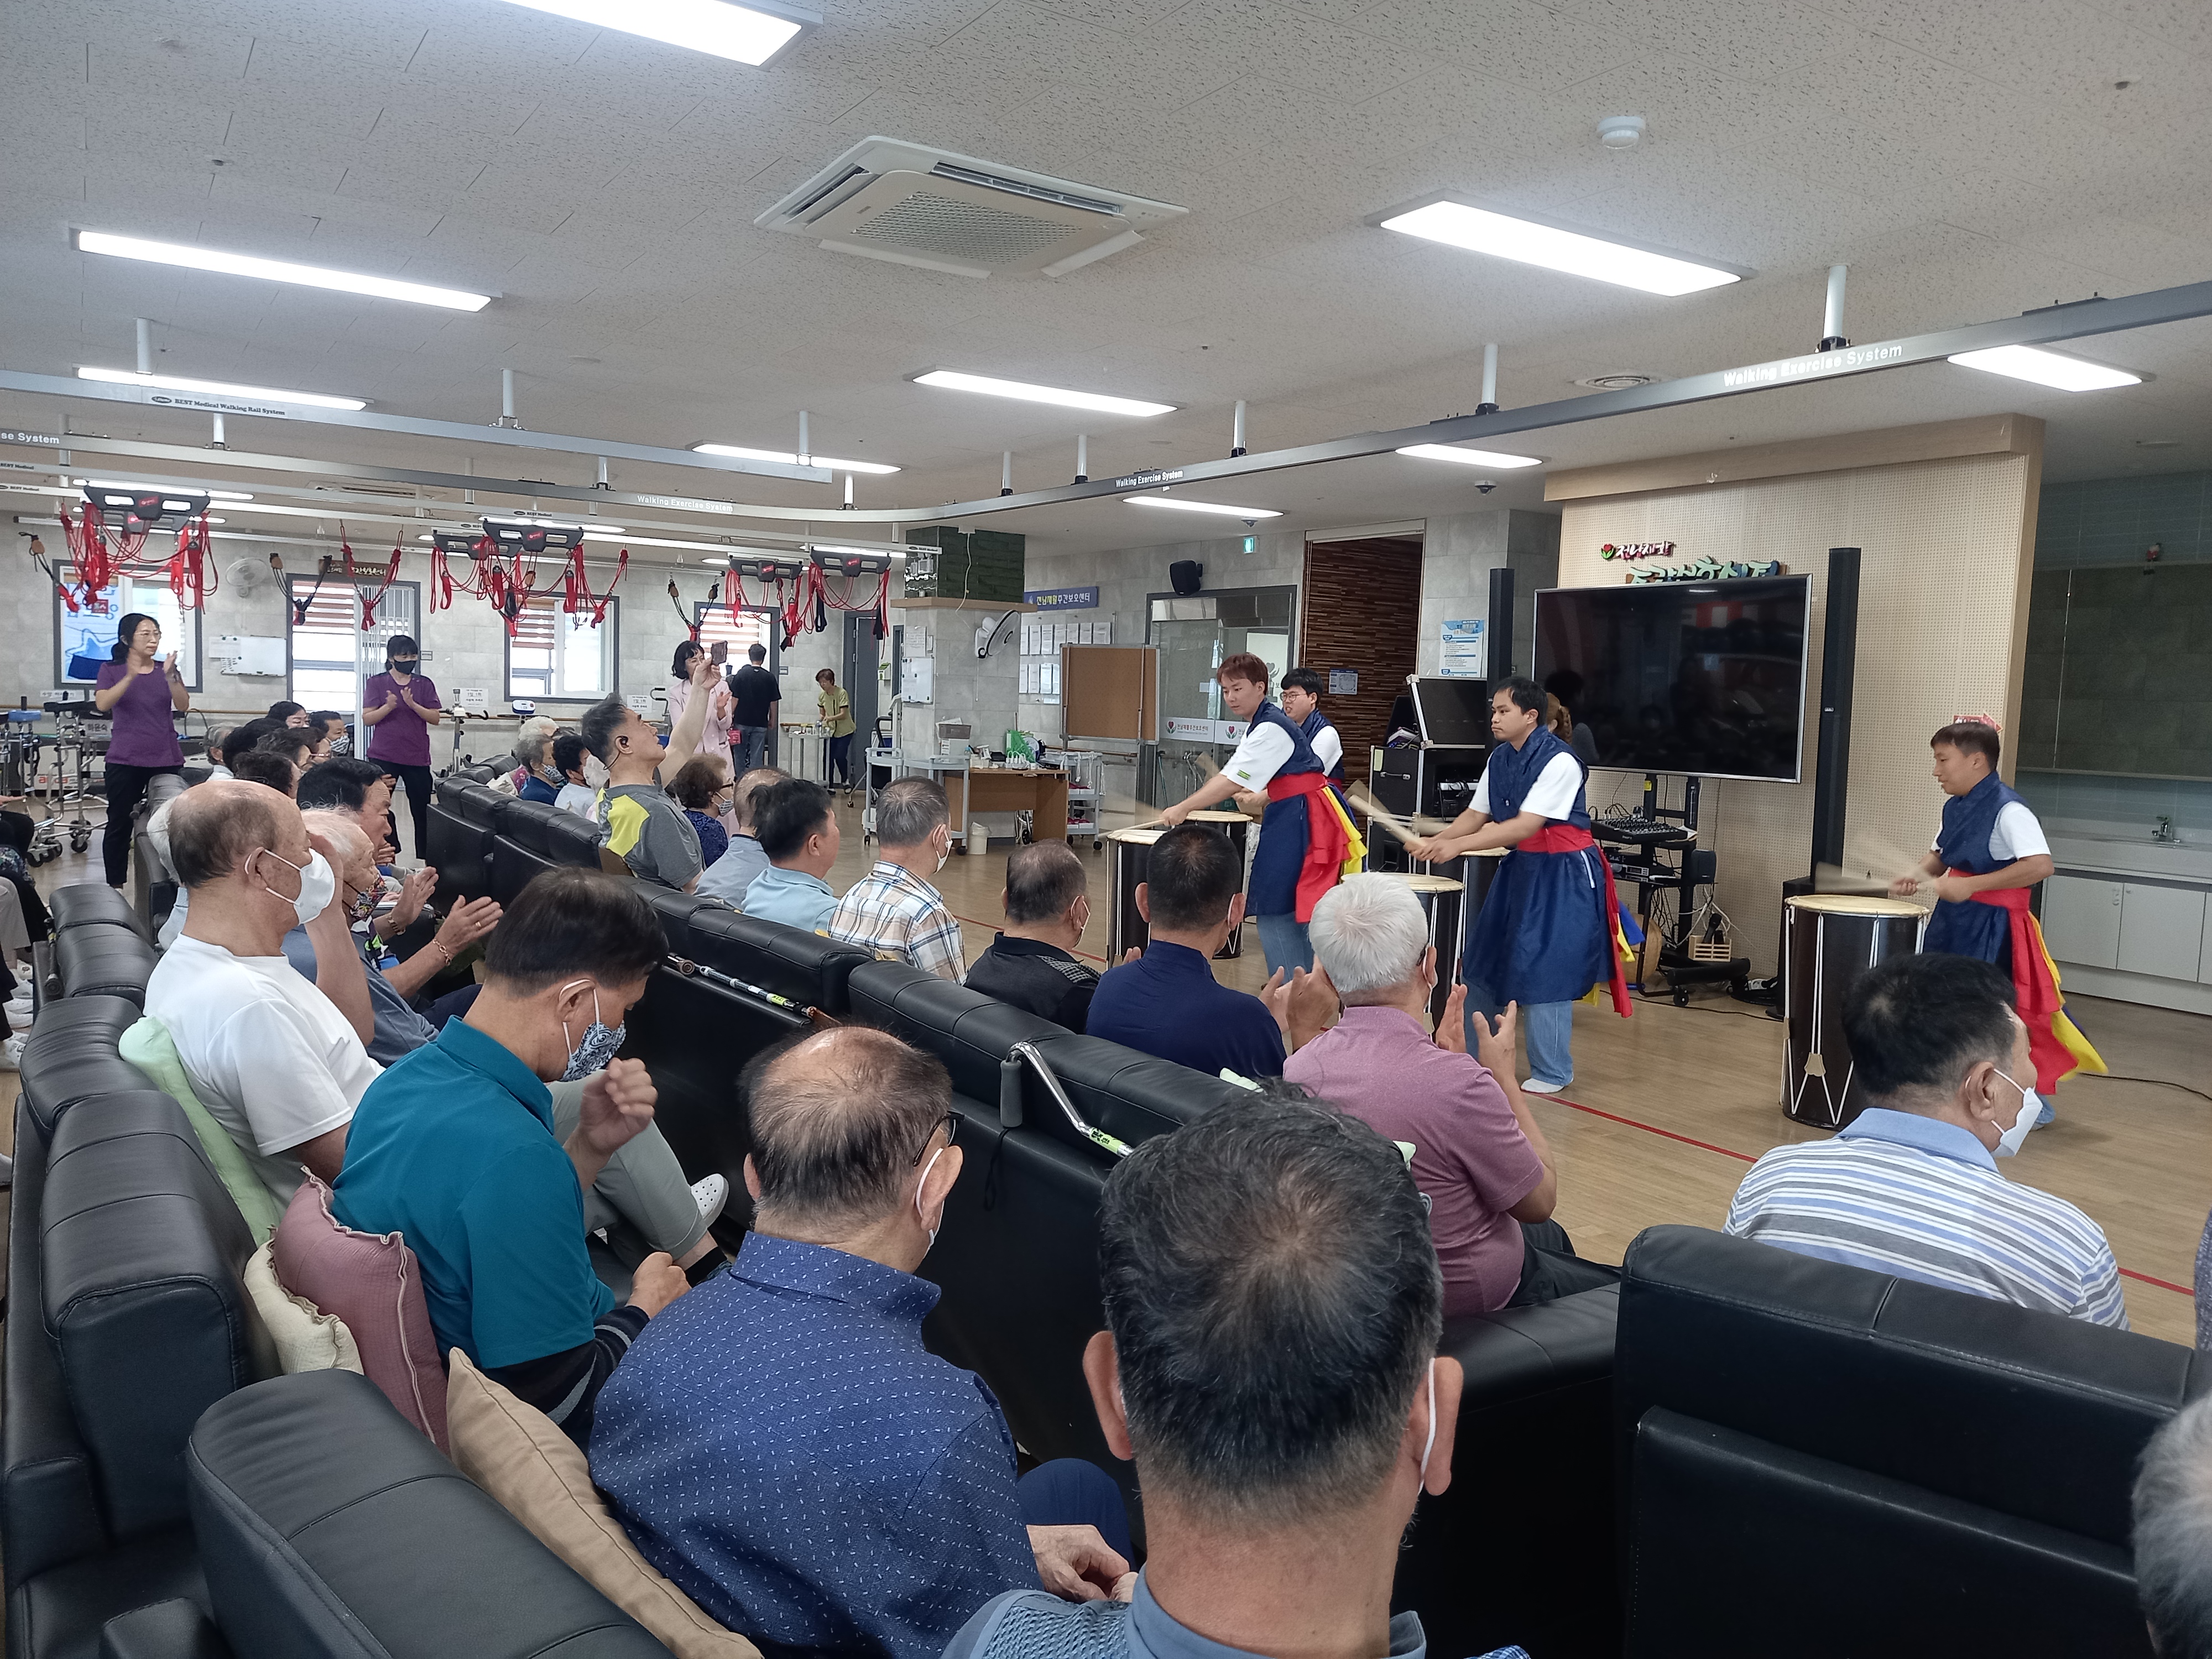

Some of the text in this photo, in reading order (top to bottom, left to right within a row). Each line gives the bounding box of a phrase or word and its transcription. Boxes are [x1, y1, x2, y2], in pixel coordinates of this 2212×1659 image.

[1724, 345, 1902, 387] Walking Exercise System
[221, 403, 247, 412] Walking
[18, 432, 60, 444] System
[1115, 470, 1183, 487] Walking Exercise System
[637, 495, 733, 512] Walking Exercise System
[1615, 540, 1672, 560] 전남재활
[1036, 592, 1090, 606] 전남재활주간보호센터
